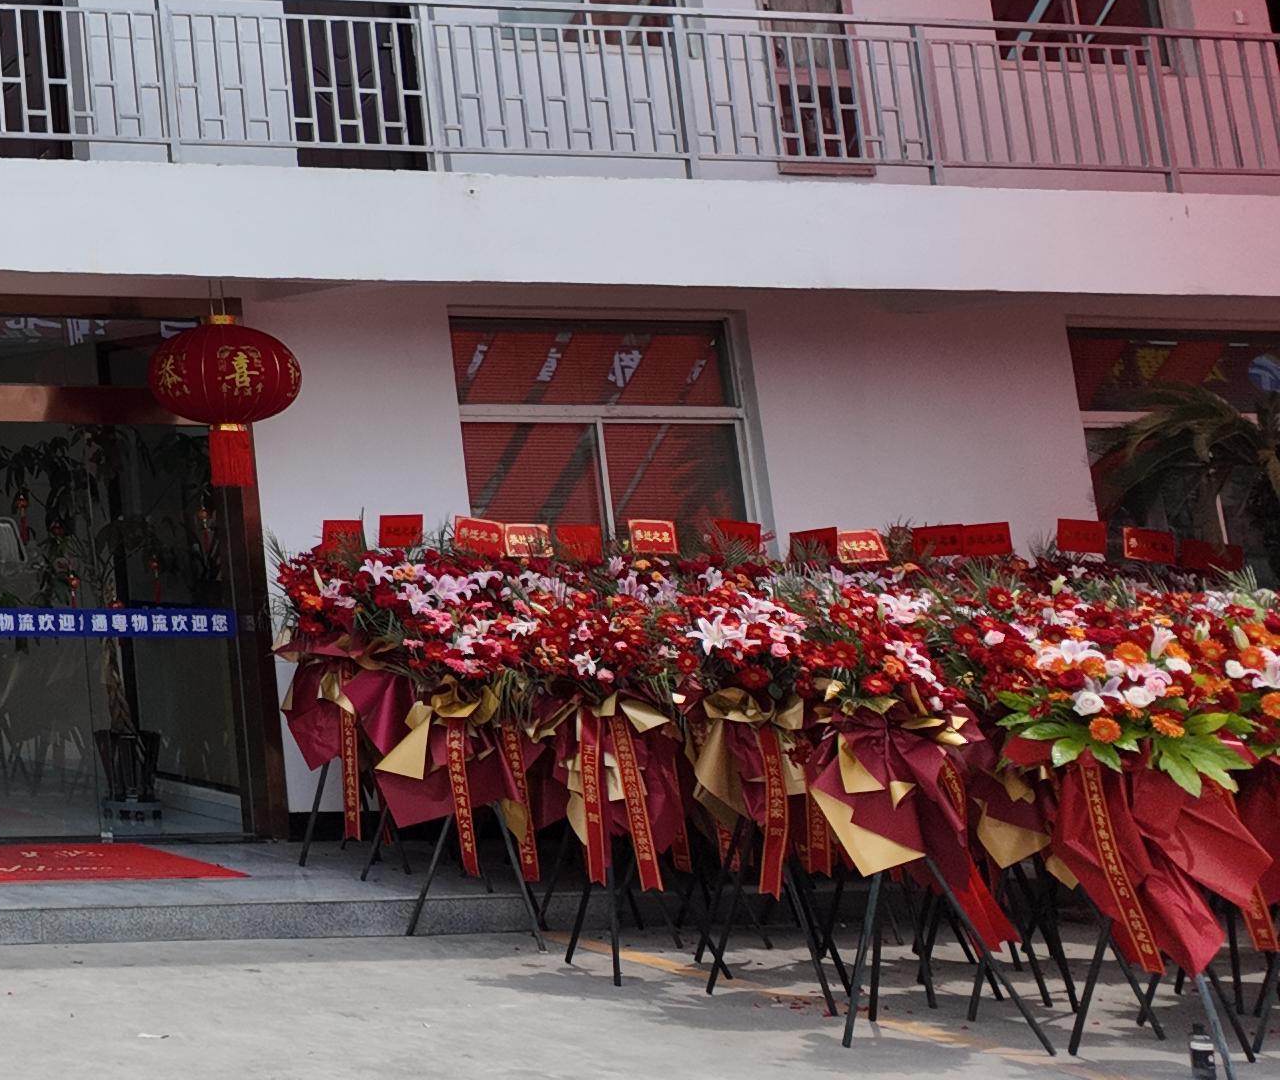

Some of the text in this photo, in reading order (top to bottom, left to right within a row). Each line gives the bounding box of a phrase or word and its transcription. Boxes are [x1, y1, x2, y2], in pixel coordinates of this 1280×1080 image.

[91, 612, 229, 635] 通粤物流欢迎您
